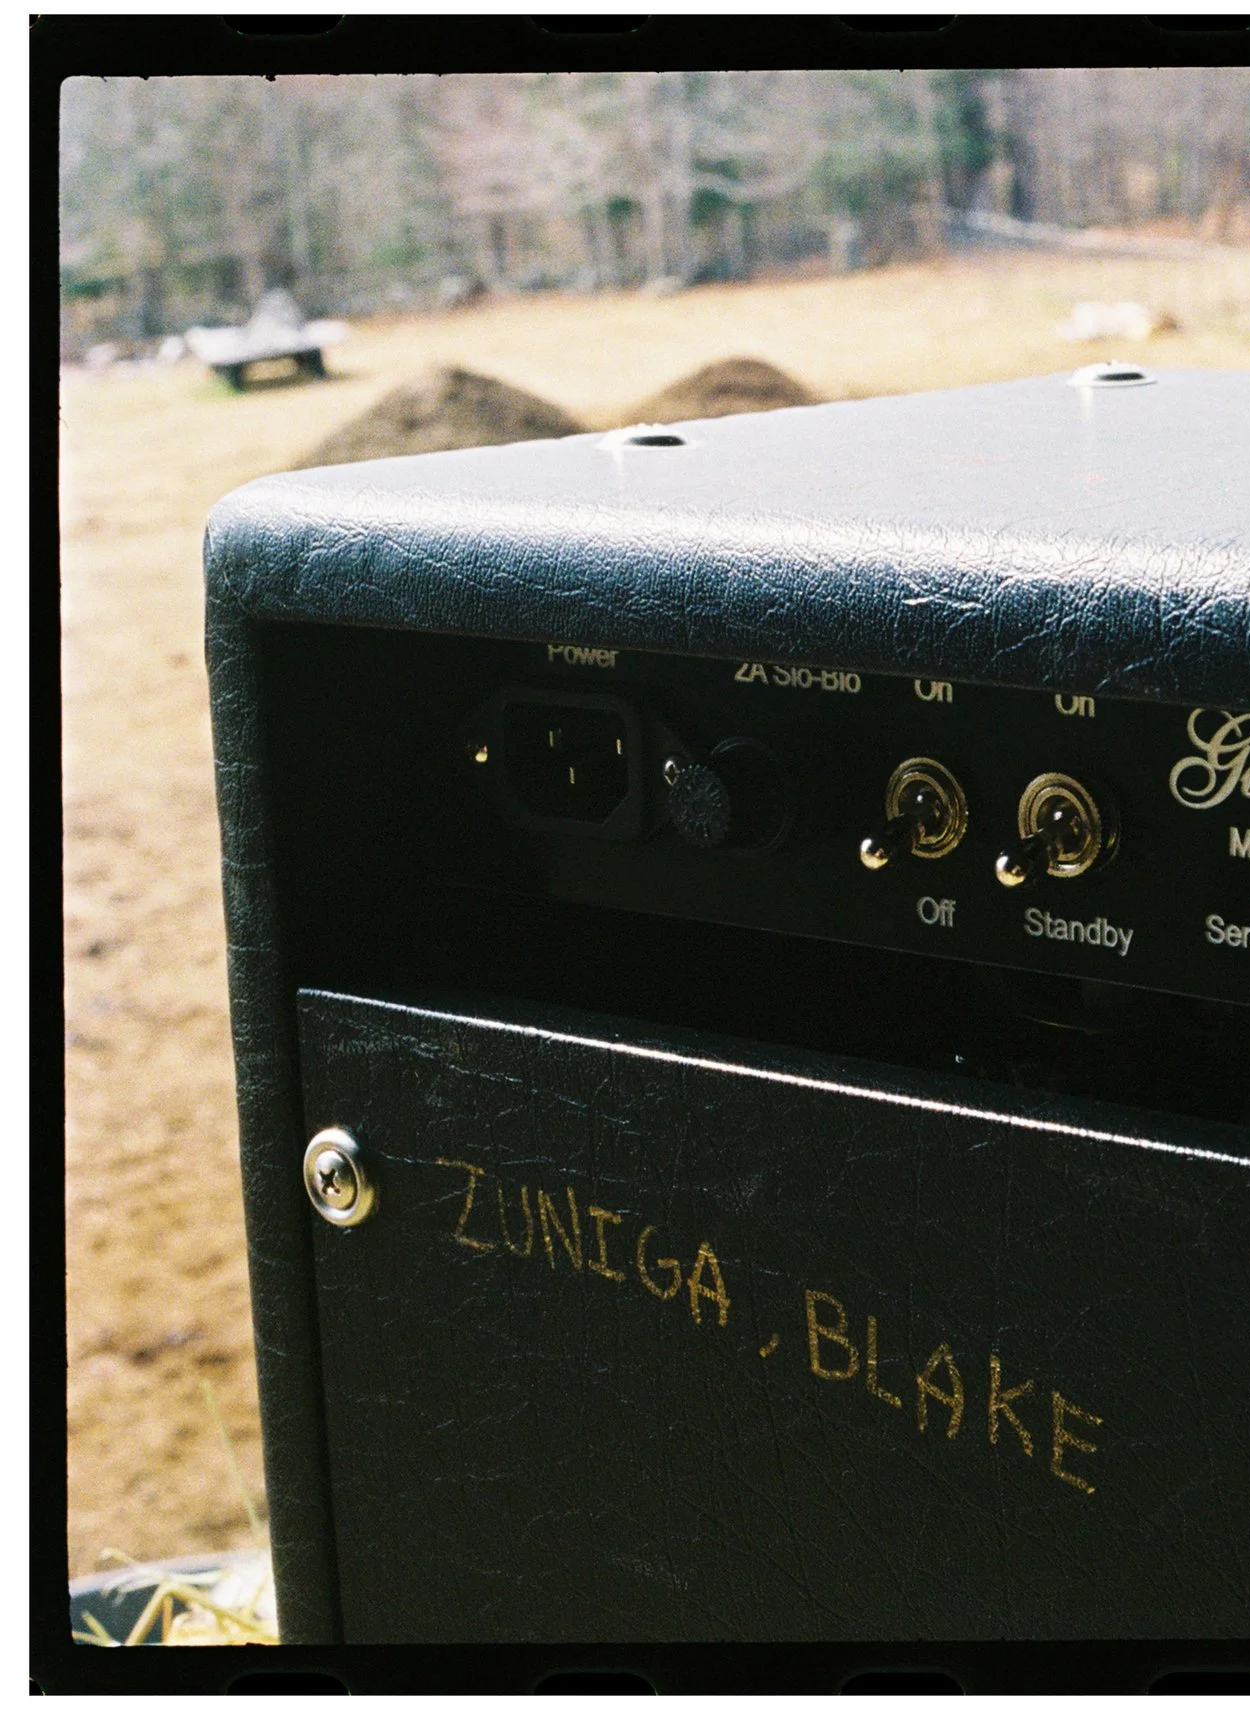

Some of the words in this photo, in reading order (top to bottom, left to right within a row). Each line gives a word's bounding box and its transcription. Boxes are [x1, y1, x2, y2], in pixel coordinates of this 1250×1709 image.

[547, 644, 620, 669] Power
[914, 679, 954, 704] On
[1054, 693, 1096, 718] On
[916, 896, 957, 928] Off
[1023, 906, 1134, 957] Standby
[805, 1289, 1103, 1495] BLAKE
